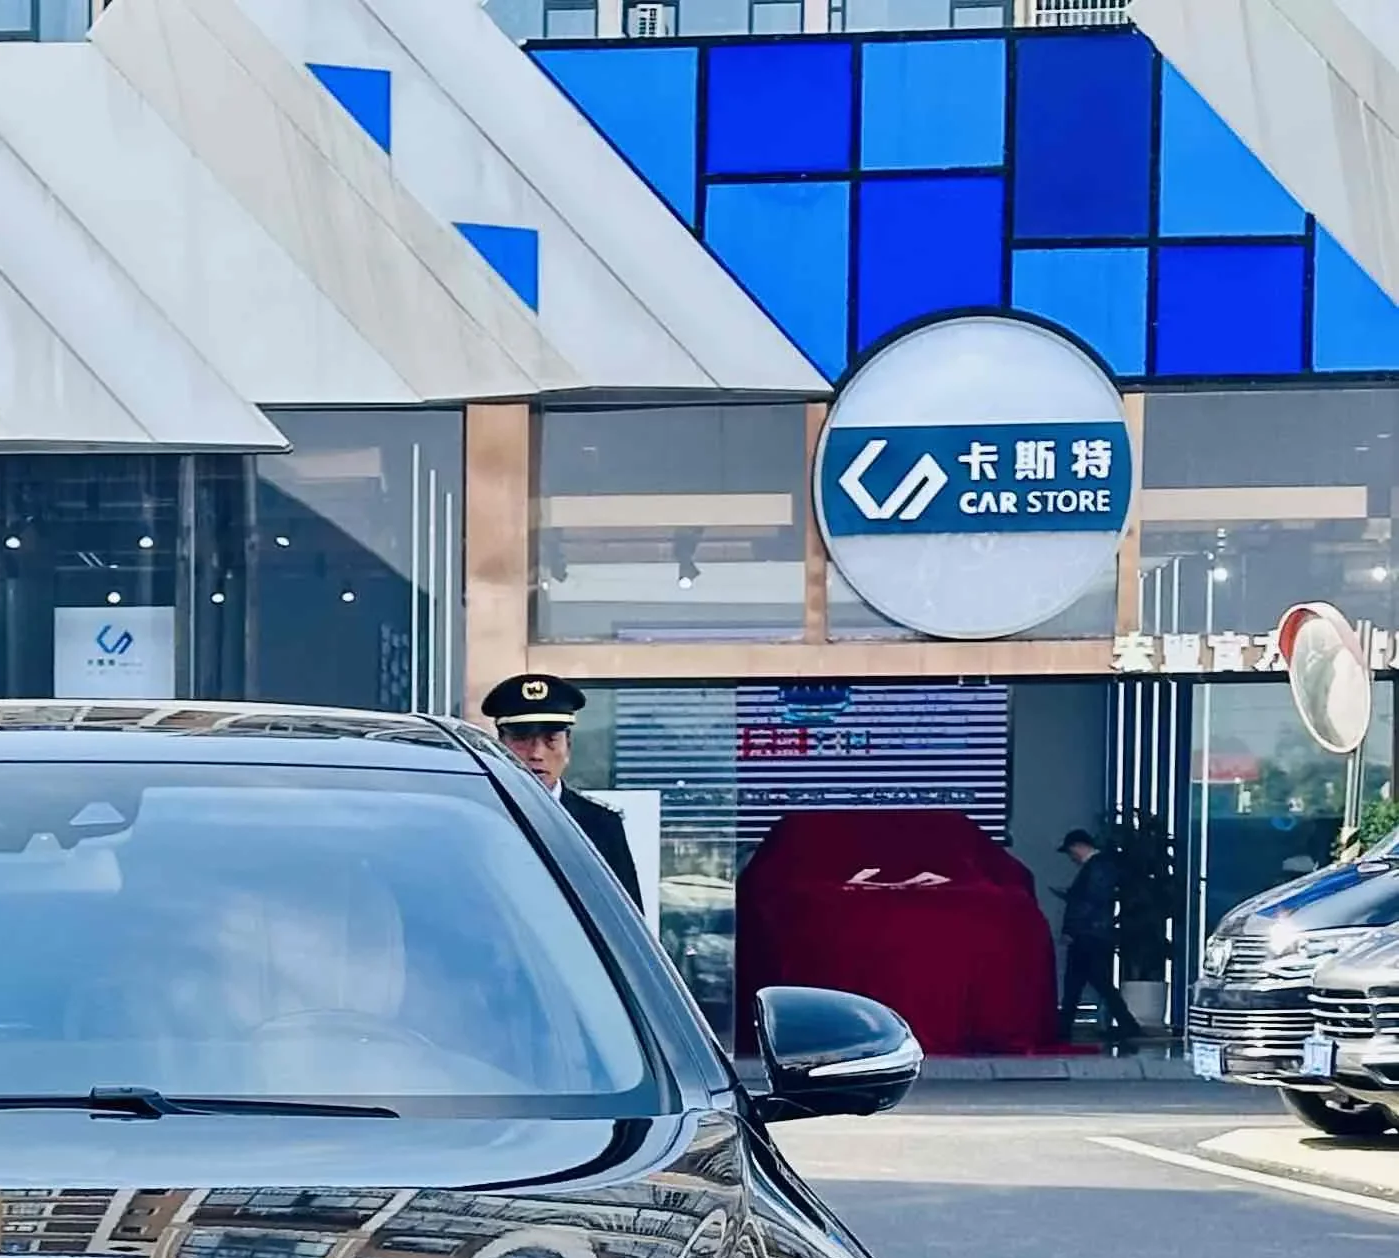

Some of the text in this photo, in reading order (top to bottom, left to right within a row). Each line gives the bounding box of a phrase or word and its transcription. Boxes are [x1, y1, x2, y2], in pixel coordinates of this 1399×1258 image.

[957, 439, 1113, 482] 卡斯特
[959, 489, 1111, 514] CAR STORE
